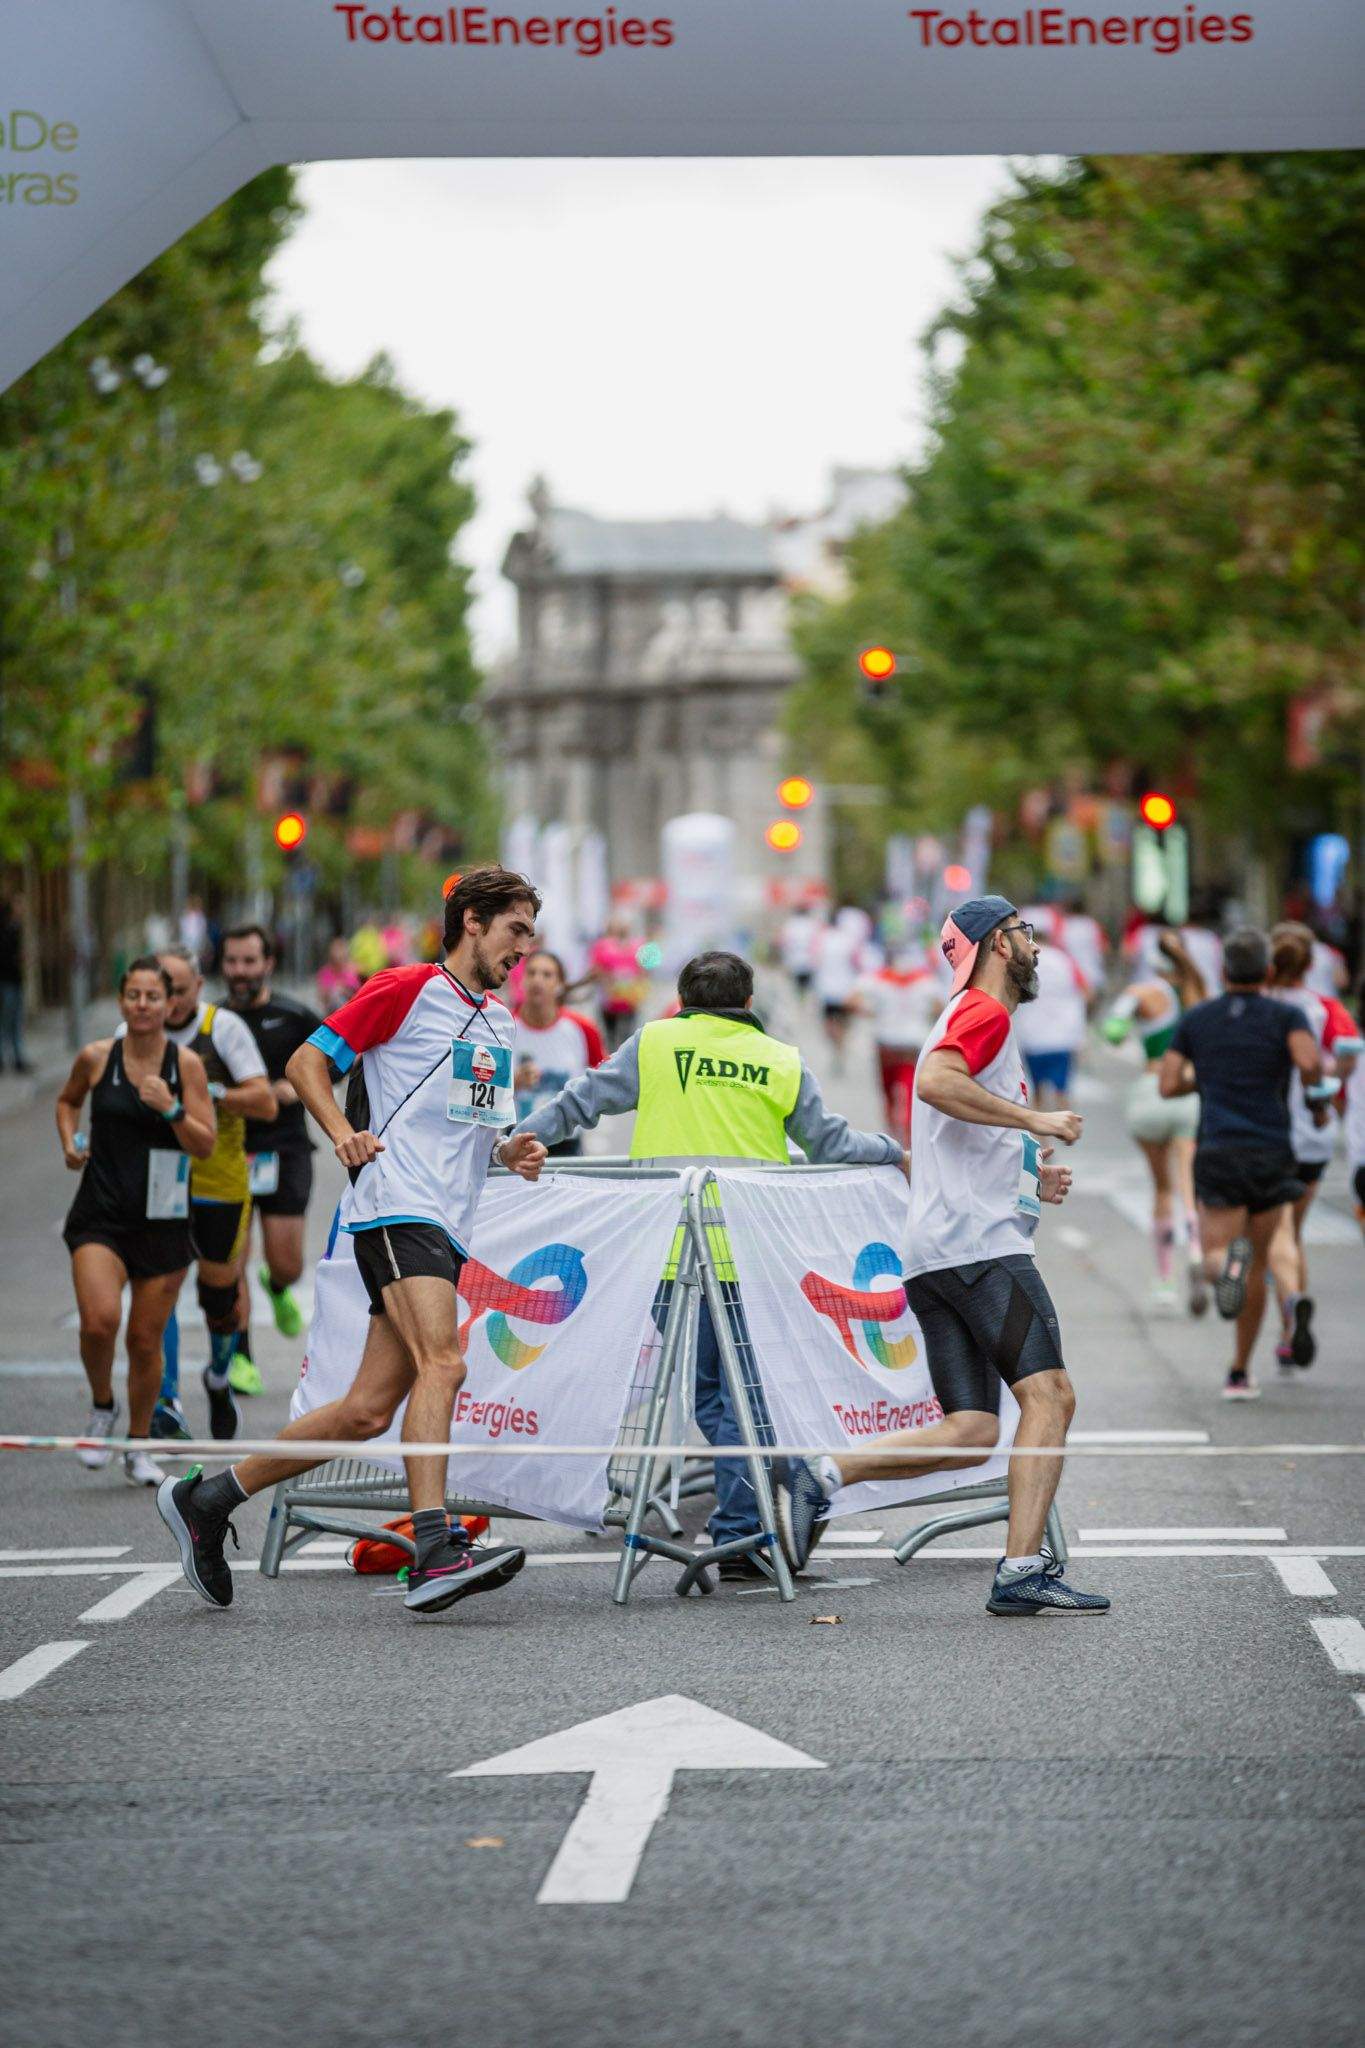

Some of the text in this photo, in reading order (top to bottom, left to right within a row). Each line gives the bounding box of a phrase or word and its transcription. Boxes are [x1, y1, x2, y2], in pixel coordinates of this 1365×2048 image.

[334, 3, 675, 56] TotalEnergies
[910, 5, 1254, 54] TotalEnergies
[0, 110, 79, 152] De
[0, 171, 80, 206] ras
[695, 1057, 770, 1086] ADM
[469, 1083, 496, 1109] 124
